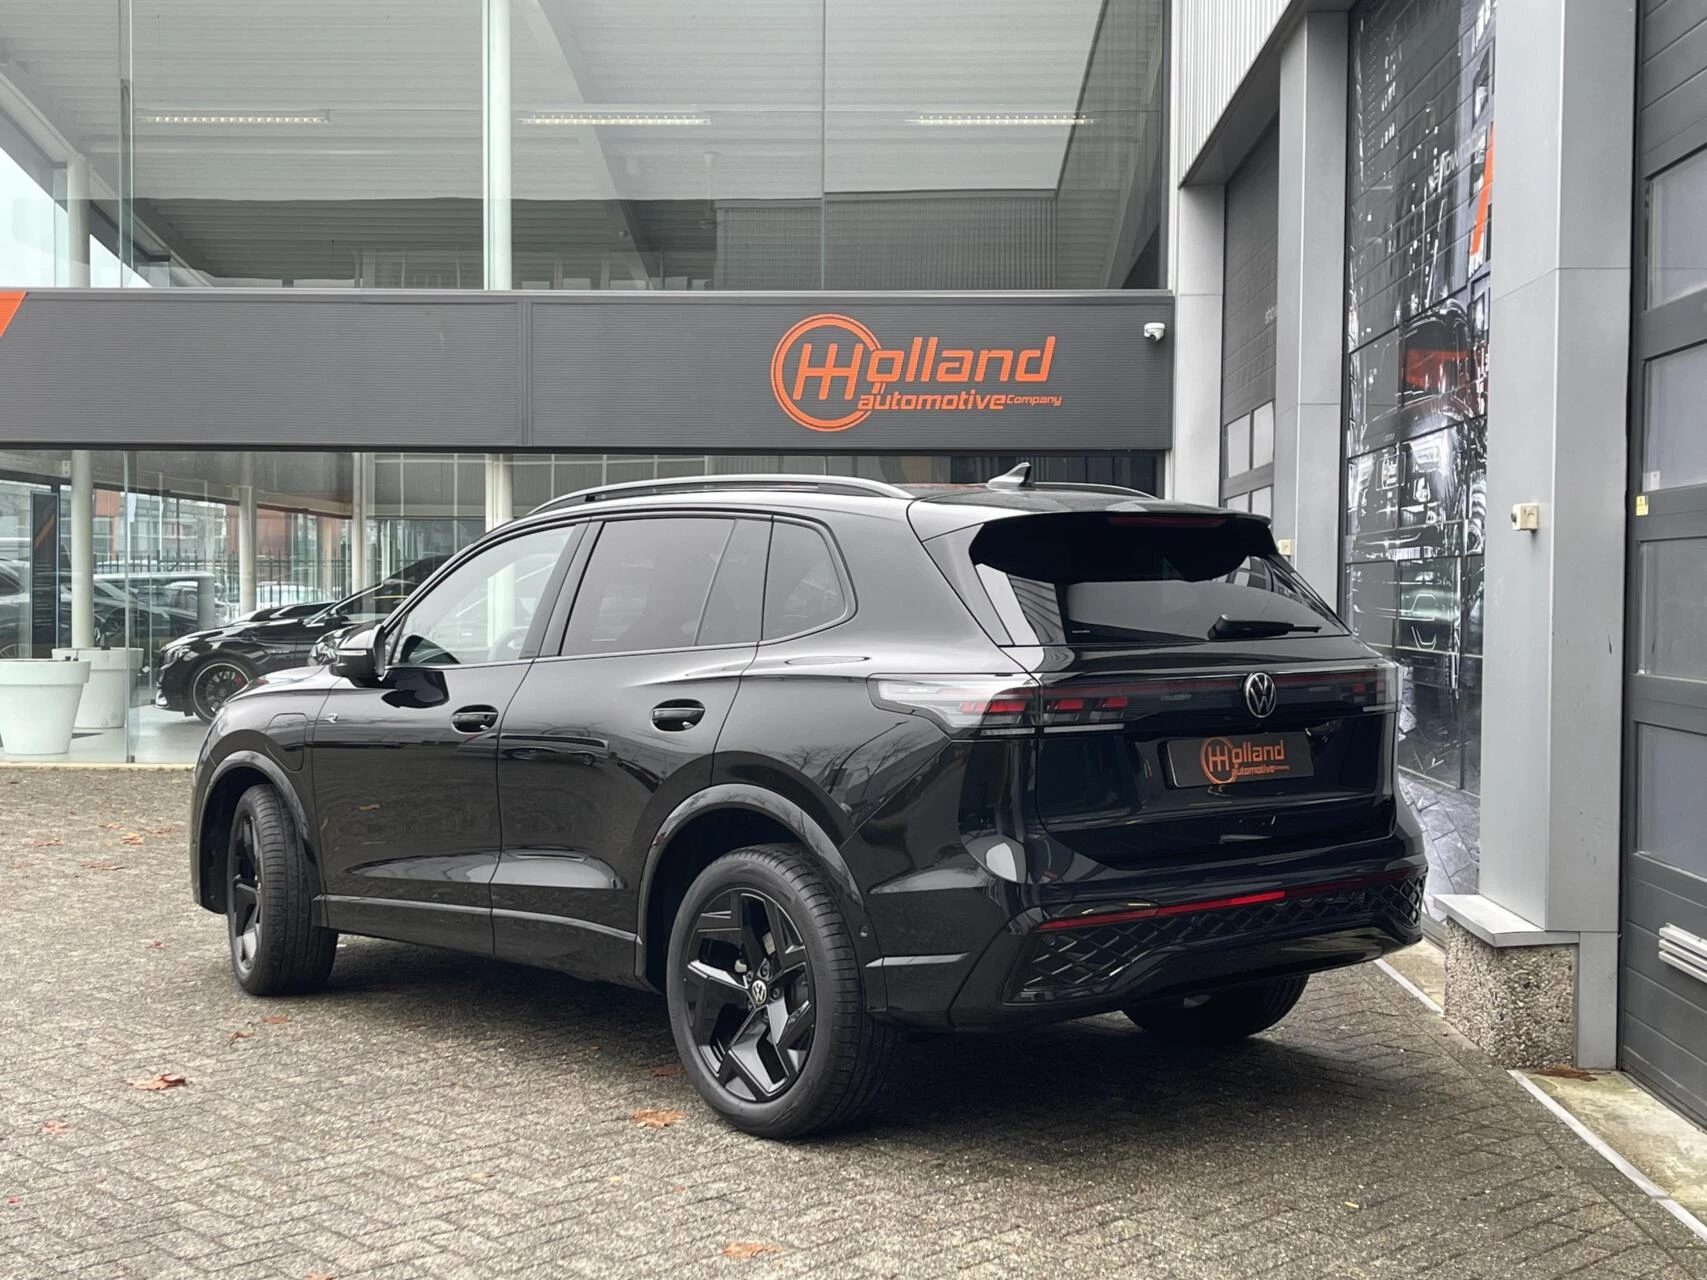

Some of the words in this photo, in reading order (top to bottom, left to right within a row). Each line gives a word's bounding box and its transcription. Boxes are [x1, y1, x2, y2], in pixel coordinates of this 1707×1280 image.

[793, 336, 1057, 400] Holland
[857, 389, 1005, 410] automotive
[1208, 739, 1285, 772] Holland
